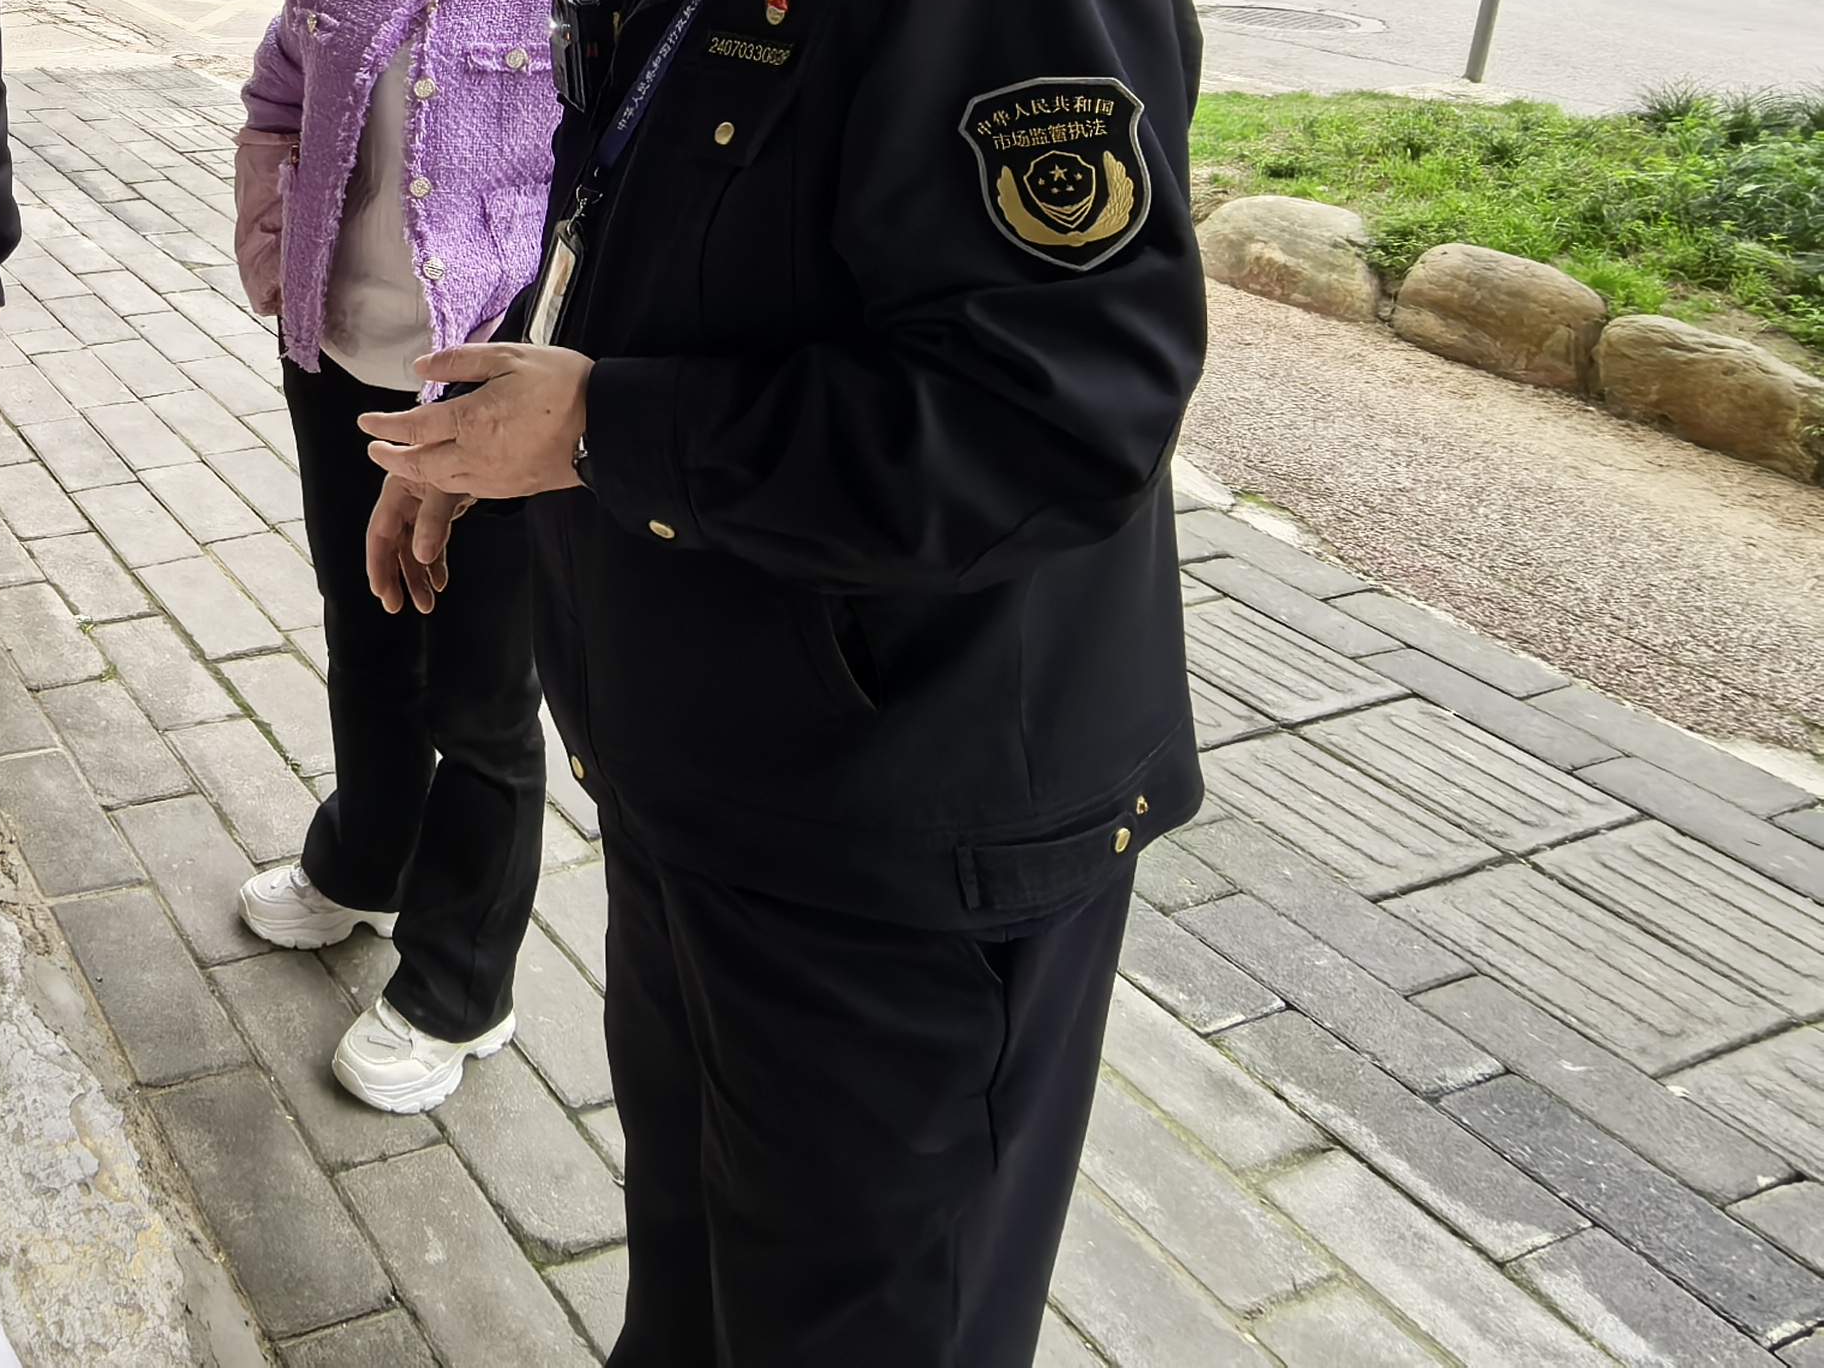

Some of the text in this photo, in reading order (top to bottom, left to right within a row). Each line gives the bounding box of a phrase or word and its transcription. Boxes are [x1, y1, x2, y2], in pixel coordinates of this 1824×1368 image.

[977, 94, 1116, 136] 中华人民共和国
[992, 118, 1108, 151] 市场监管执法
